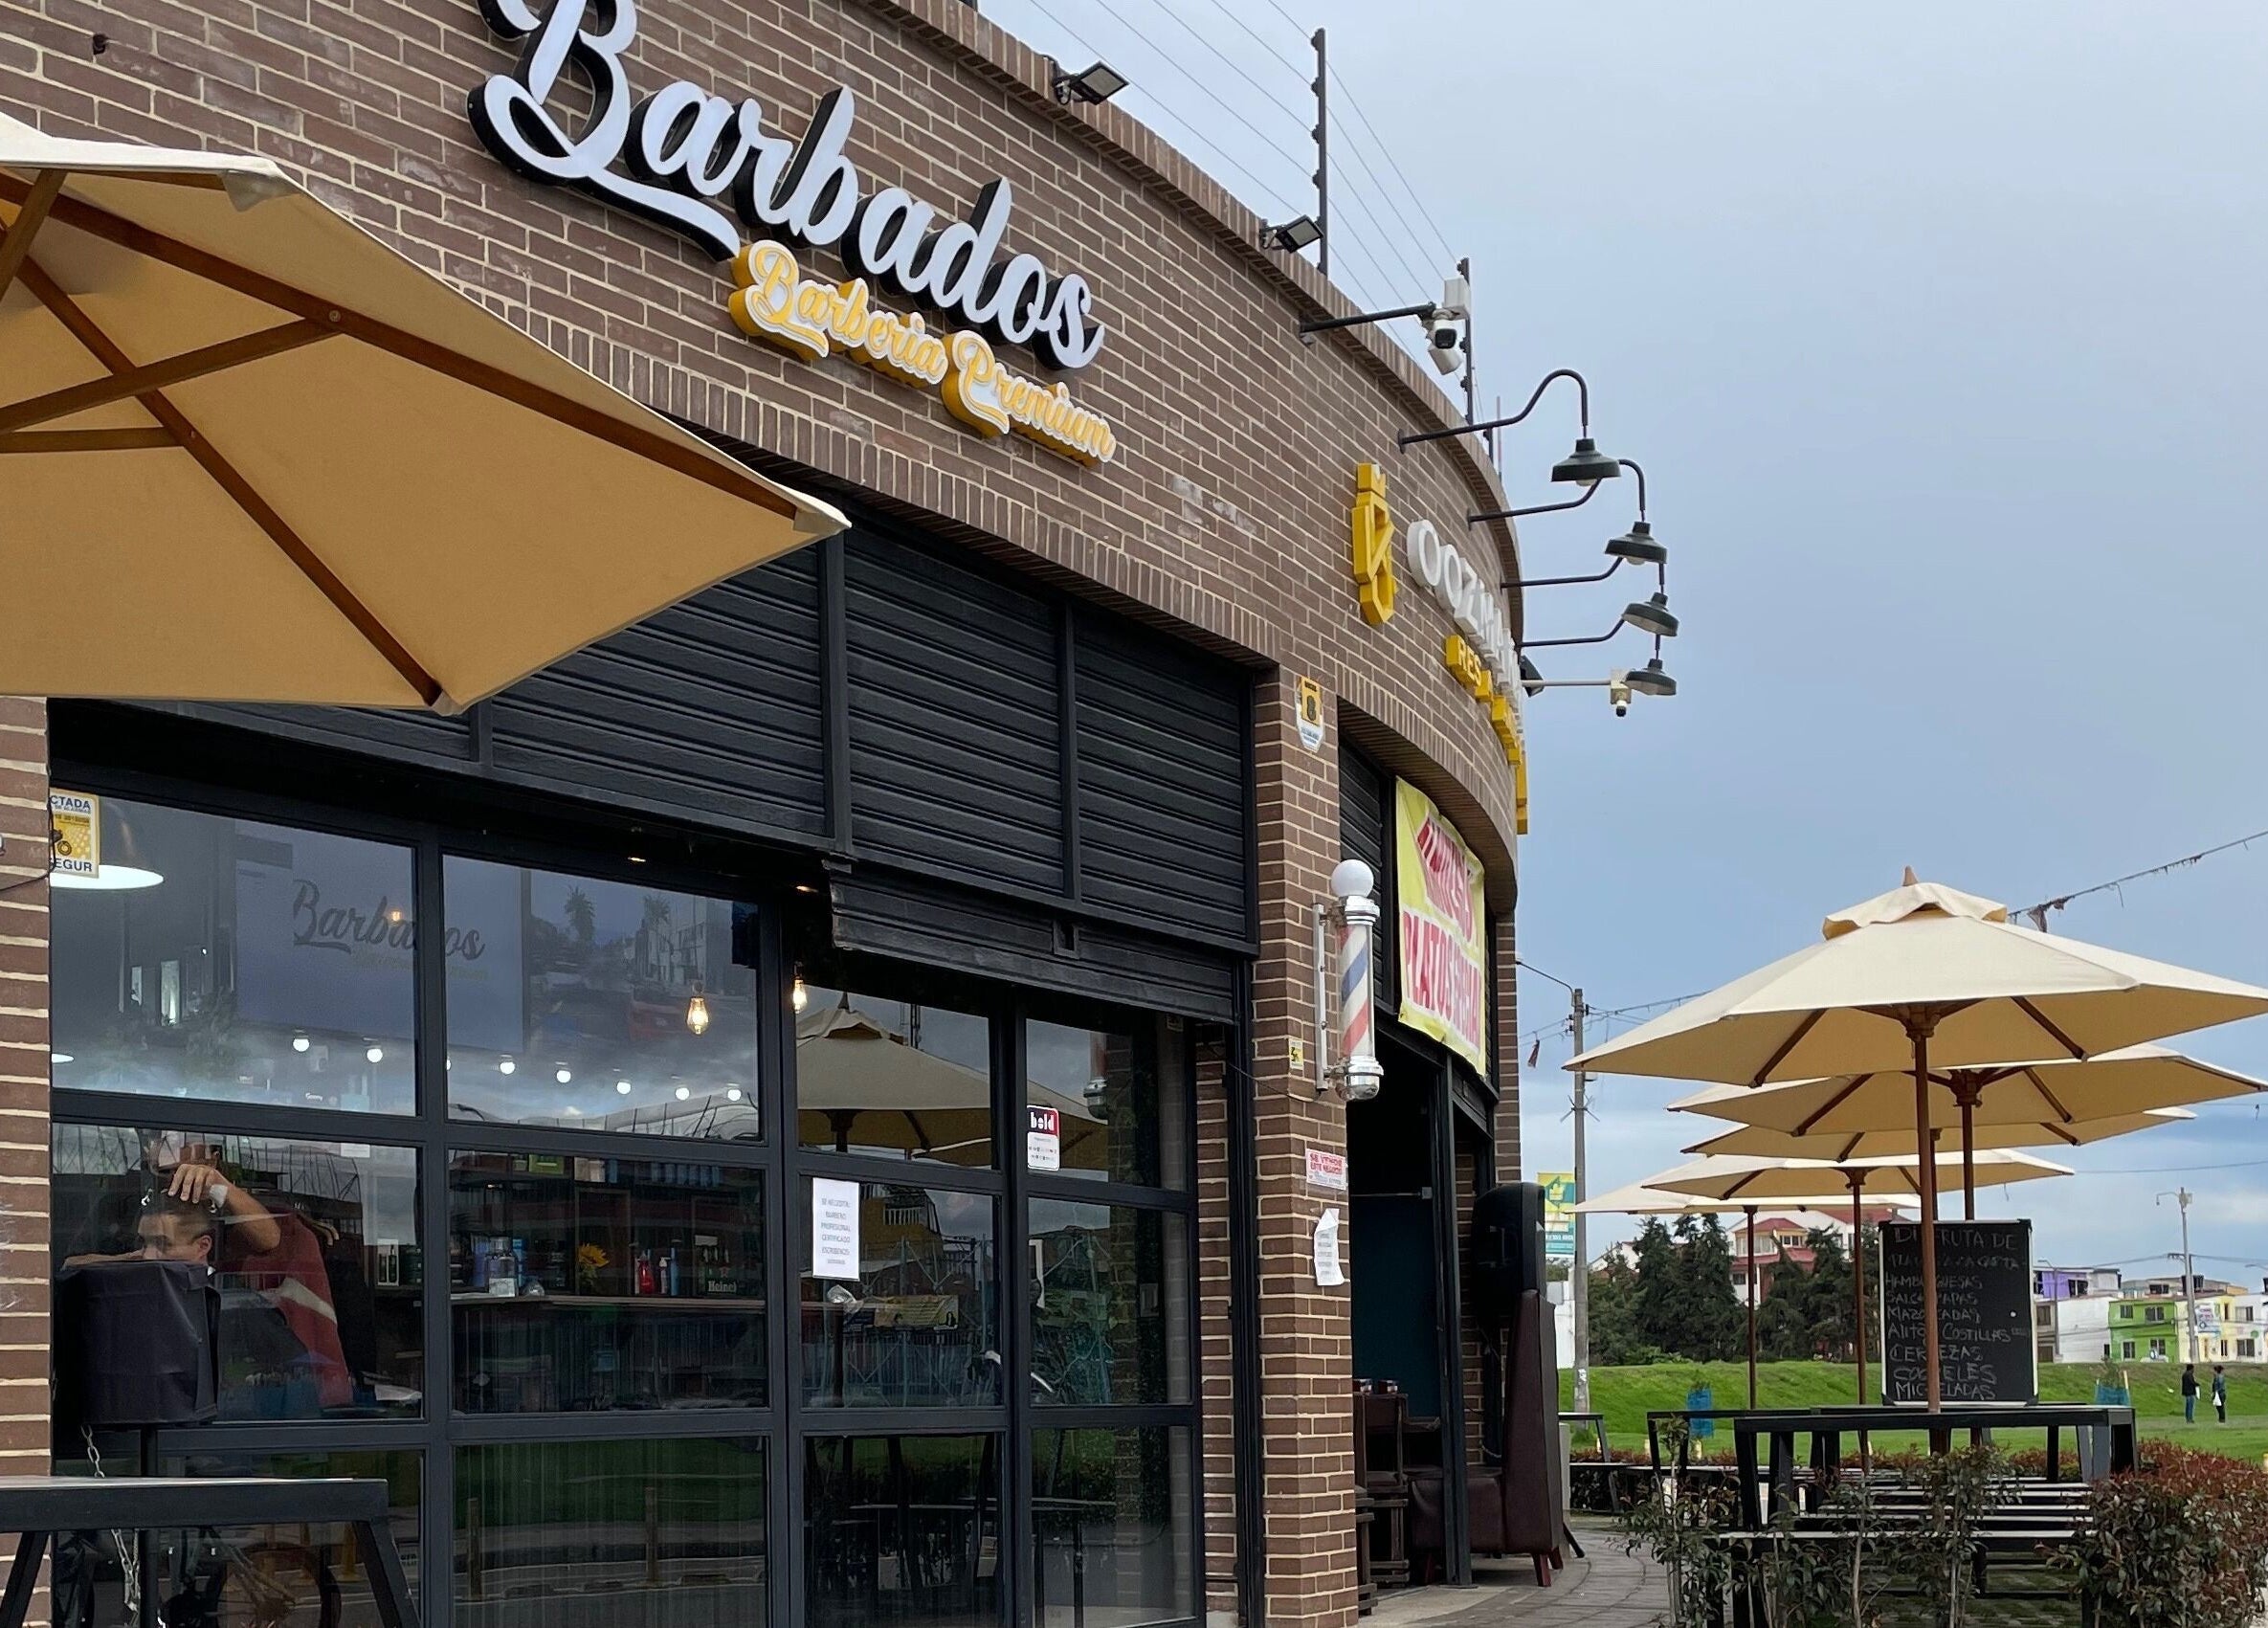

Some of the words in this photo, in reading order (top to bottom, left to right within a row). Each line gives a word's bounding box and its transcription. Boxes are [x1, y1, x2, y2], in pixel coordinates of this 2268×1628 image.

[469, 0, 1104, 369] Barbados
[943, 330, 1117, 464] Premium
[293, 879, 486, 961] Barbaos
[1889, 1343, 1984, 1362] CEREZAS
